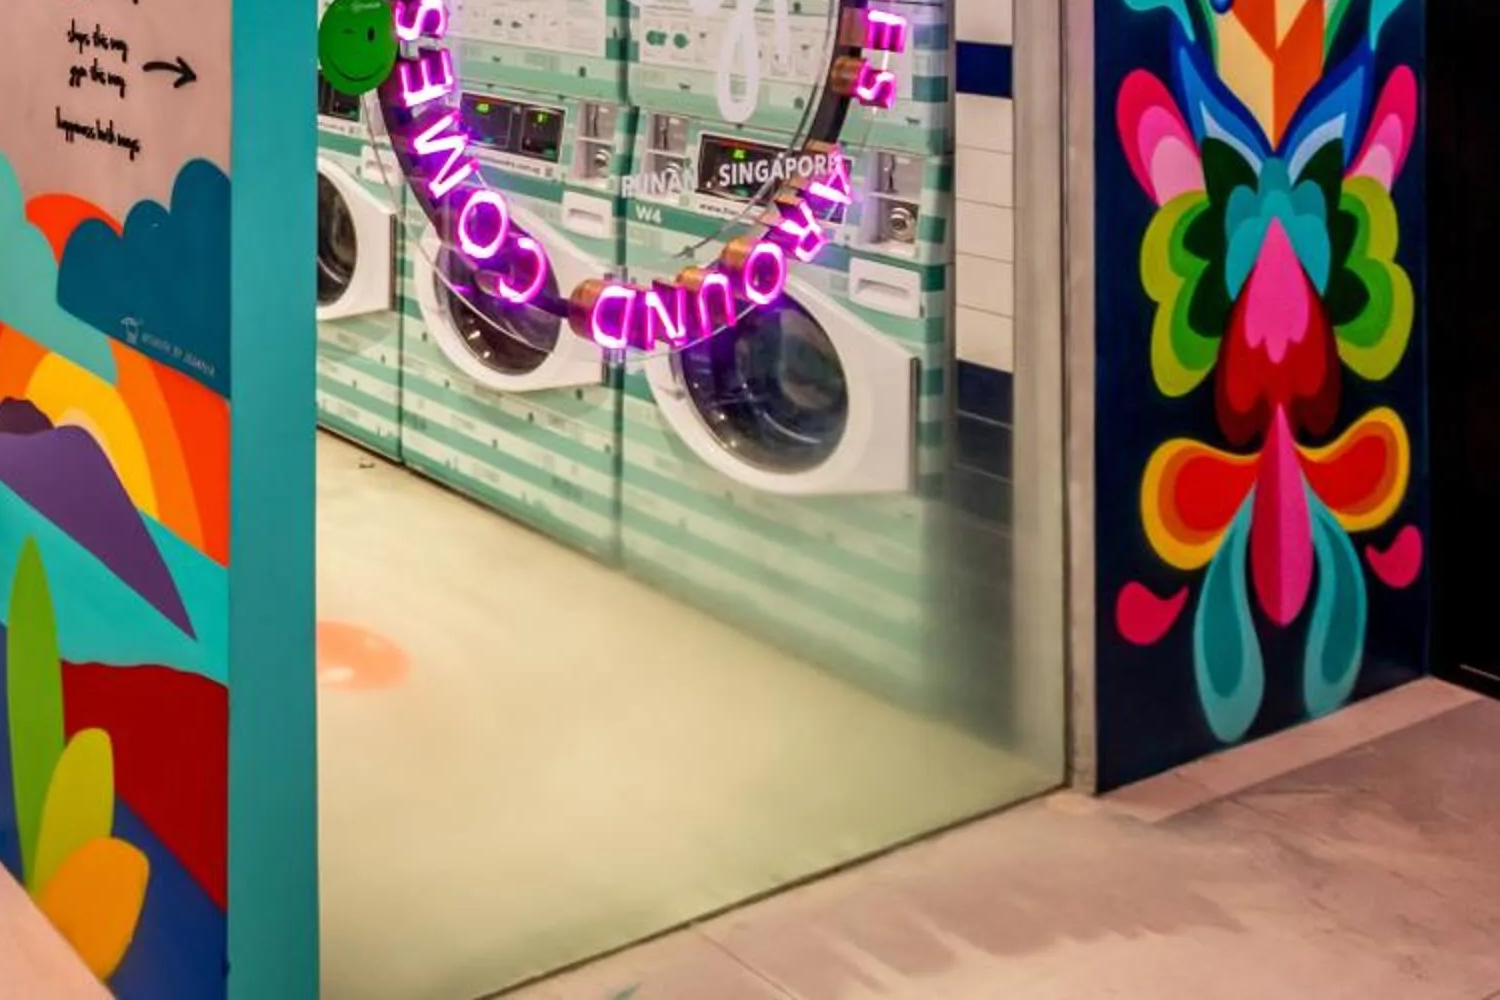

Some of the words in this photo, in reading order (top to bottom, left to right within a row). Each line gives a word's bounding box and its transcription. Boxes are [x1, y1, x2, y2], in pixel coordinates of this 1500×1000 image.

[718, 154, 840, 187] SINGAPORE
[635, 204, 662, 223] W4
[590, 143, 853, 351] AROUND
